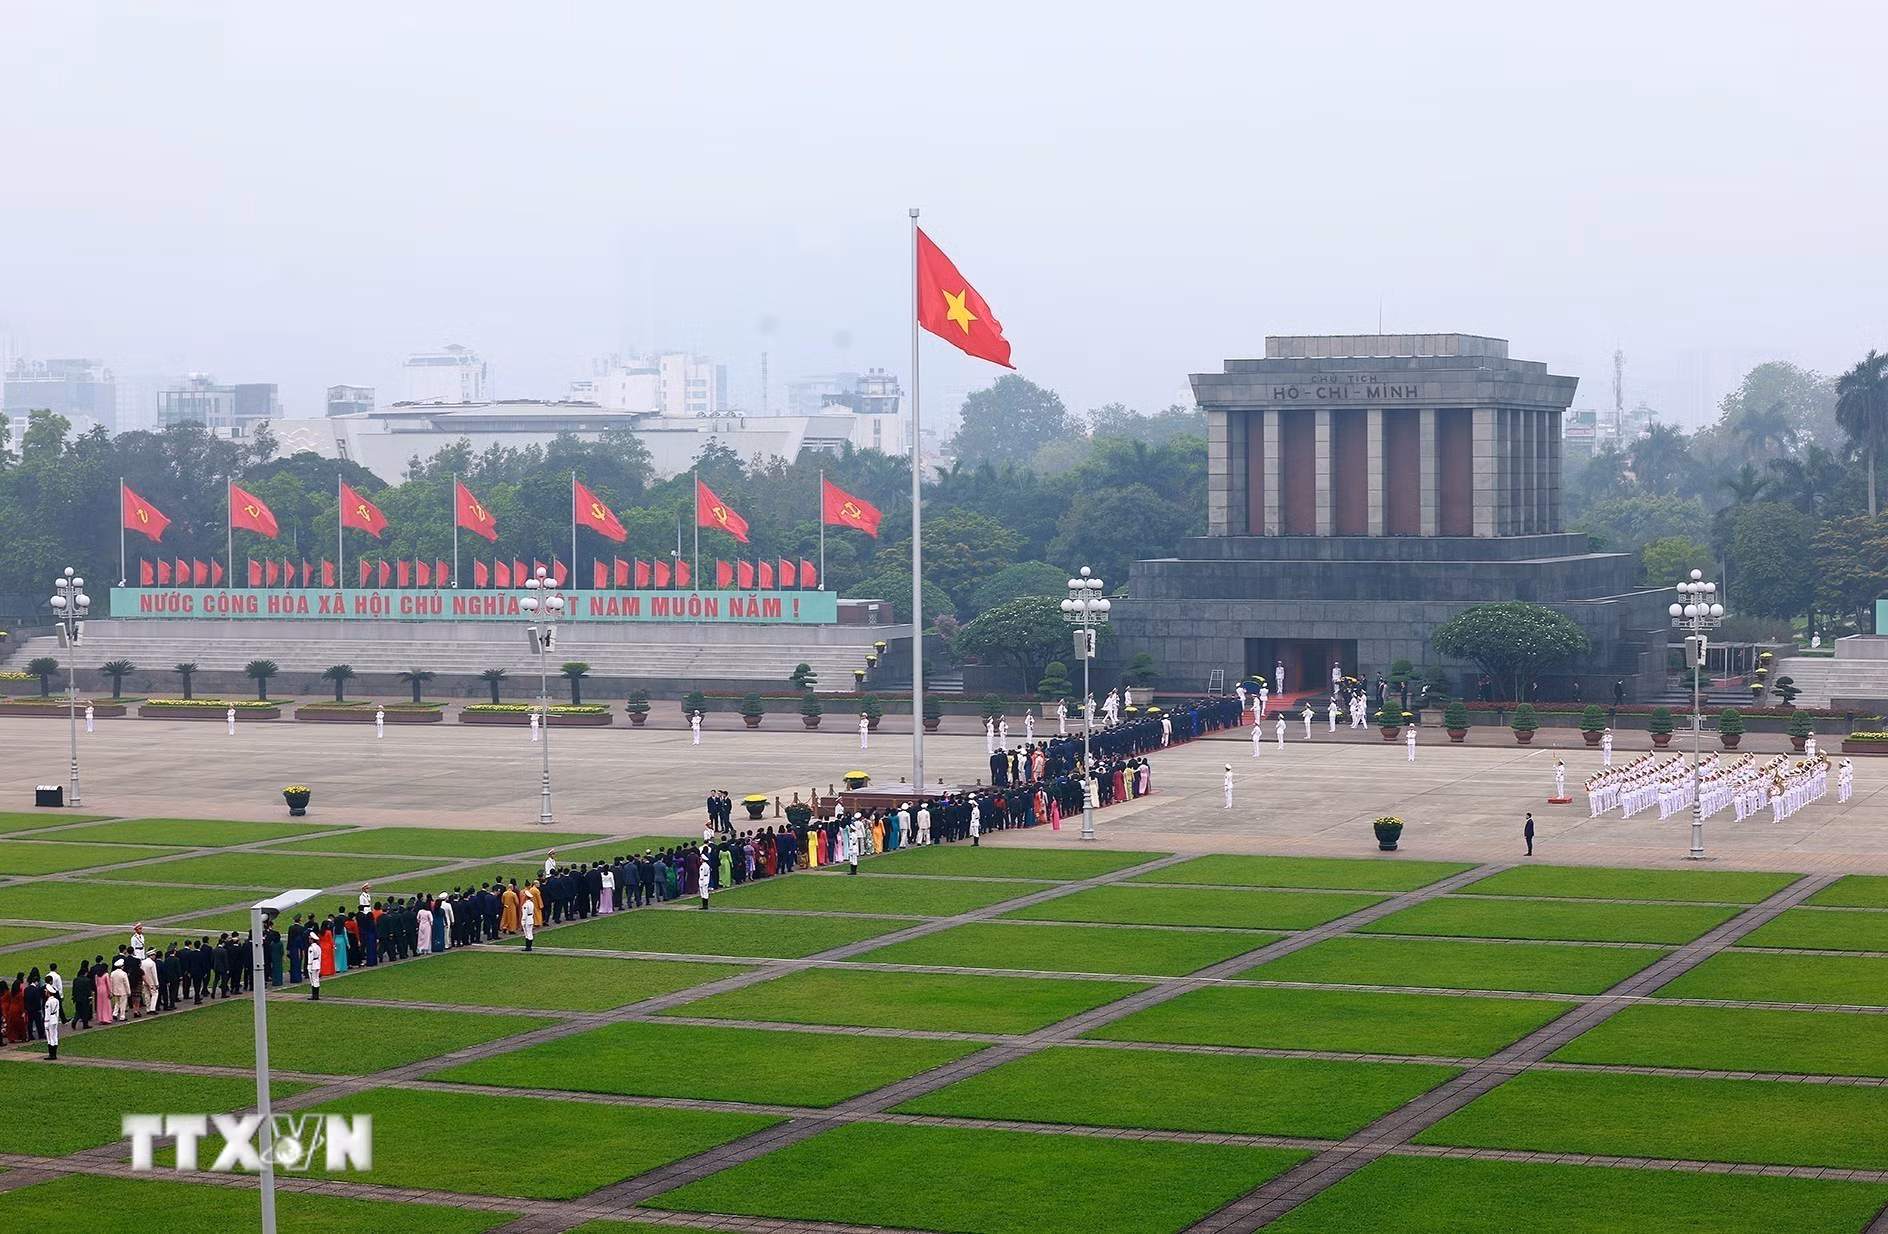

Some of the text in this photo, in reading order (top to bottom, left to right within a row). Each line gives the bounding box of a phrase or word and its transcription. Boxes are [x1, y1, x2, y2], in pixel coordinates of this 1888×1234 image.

[140, 591, 194, 614] NƯỚC
[203, 591, 259, 616] CỘNG
[268, 592, 309, 614] HÒA
[318, 592, 346, 614] XÃ
[355, 592, 391, 617] HỘI
[400, 590, 443, 615] CHỦ
[452, 593, 520, 616] NGHĨA
[590, 596, 641, 617] NAM
[651, 593, 718, 618] MUÔN
[729, 593, 782, 618] NĂM
[793, 598, 799, 618] !
